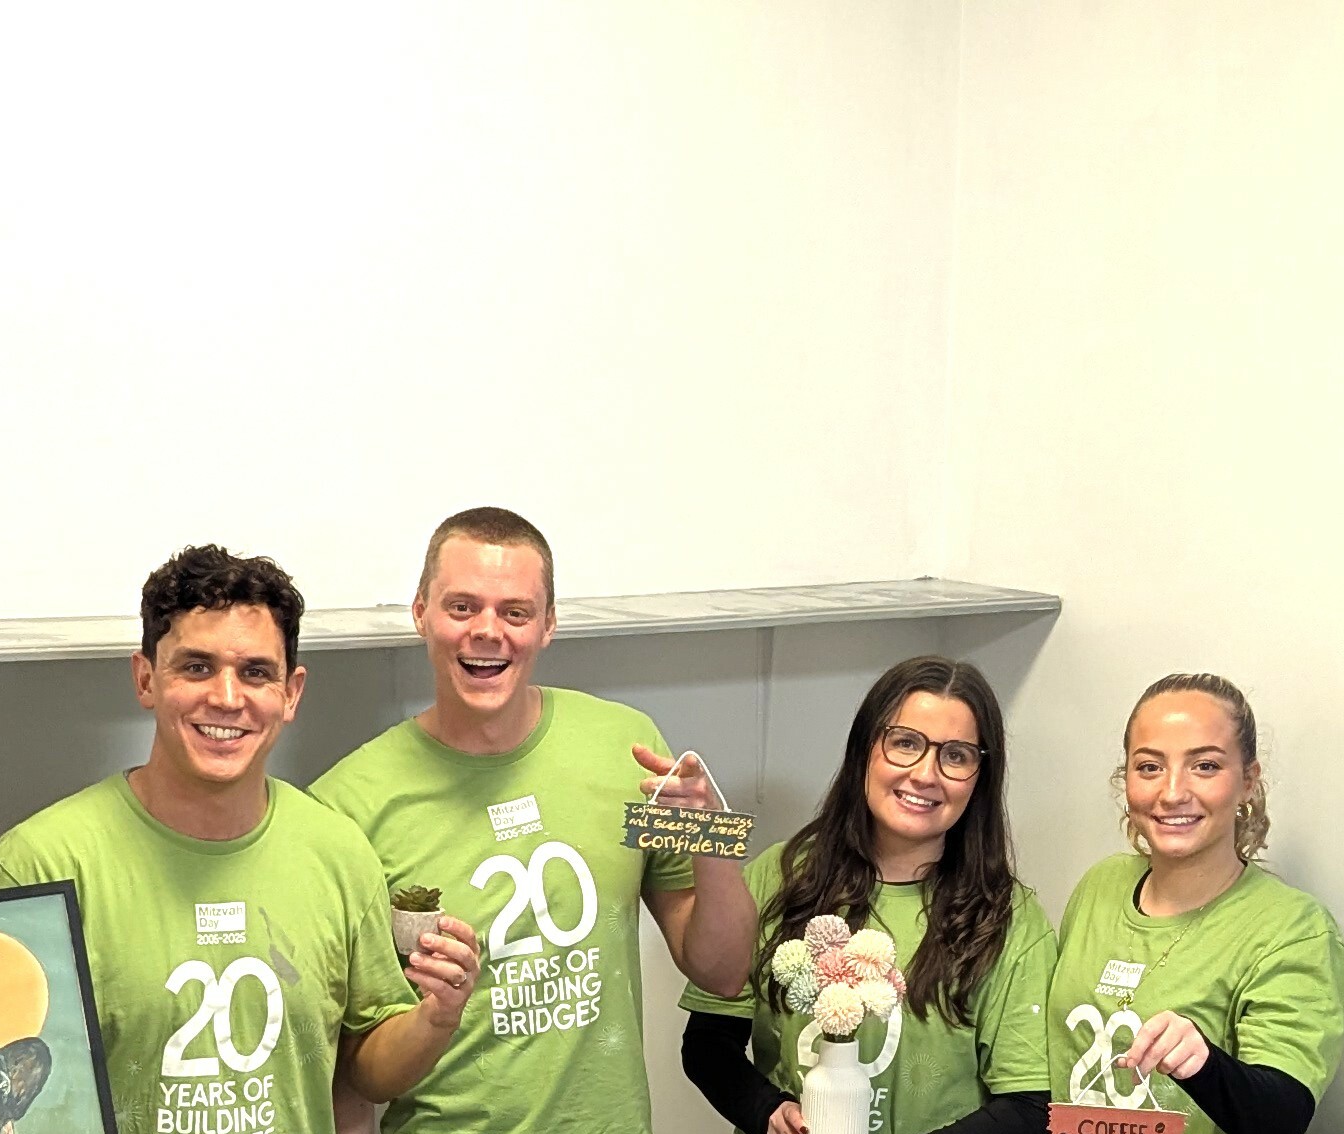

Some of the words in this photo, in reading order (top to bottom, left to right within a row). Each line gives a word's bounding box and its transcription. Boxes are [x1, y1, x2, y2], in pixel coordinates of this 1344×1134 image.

[490, 800, 534, 816] Mitzvah
[494, 816, 515, 826] Day
[198, 905, 243, 917] Mitzvah
[469, 841, 598, 961] 20
[196, 931, 246, 946] 2005-2025
[199, 917, 219, 930] Day
[487, 955, 561, 985] YEARS
[566, 947, 600, 973] OF
[1103, 971, 1121, 983] Day
[490, 972, 602, 1010] BUILDING
[161, 956, 284, 1077] 20
[492, 996, 601, 1036] BRIDGES
[1065, 1004, 1151, 1109] 20
[159, 1080, 236, 1107] YEARS
[243, 1074, 274, 1099] OF
[157, 1101, 275, 1134] BUILDING
